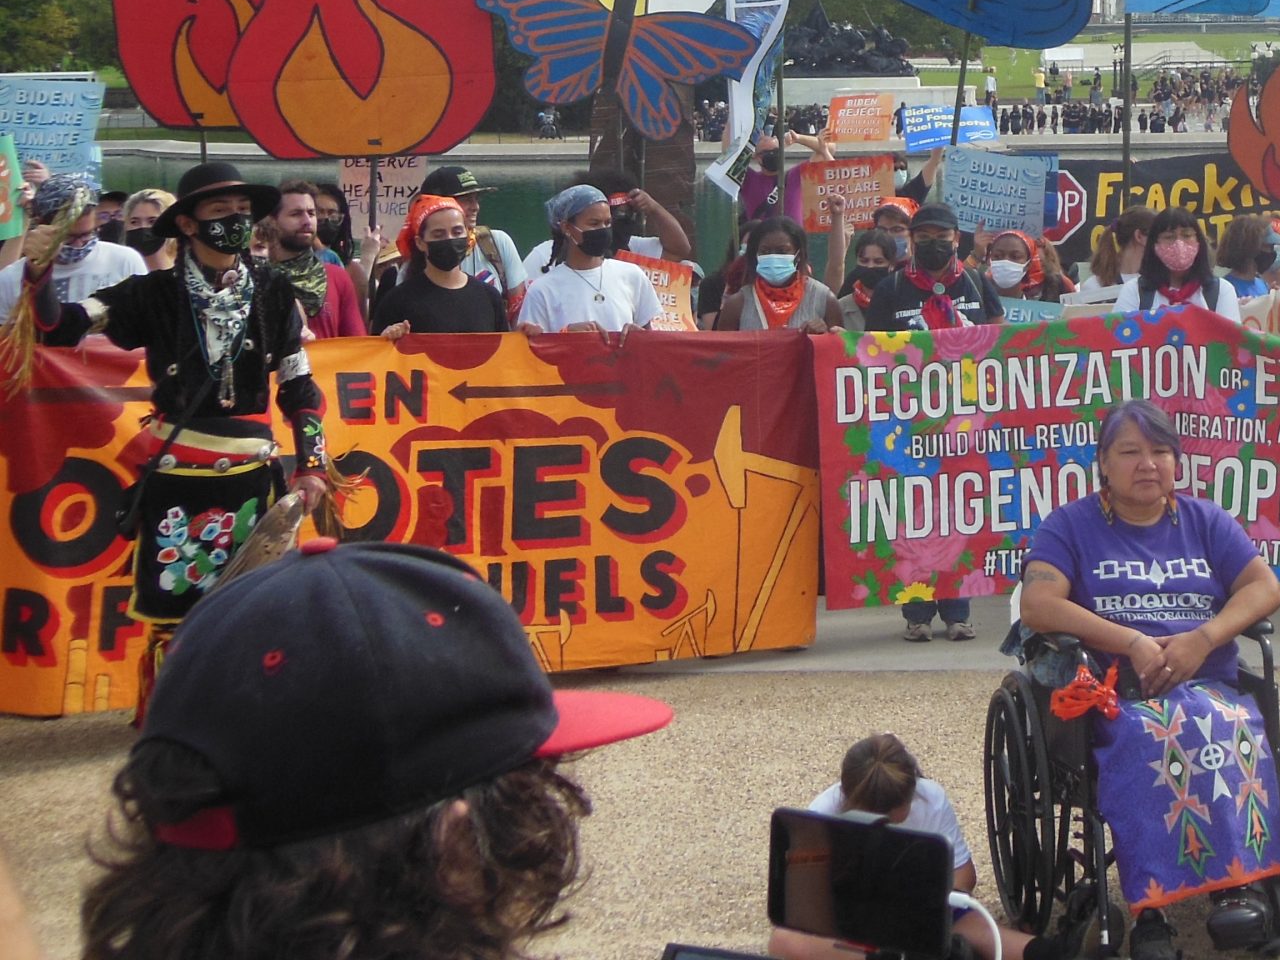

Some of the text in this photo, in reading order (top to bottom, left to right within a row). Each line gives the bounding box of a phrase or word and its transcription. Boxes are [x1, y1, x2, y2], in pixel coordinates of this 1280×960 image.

[16, 89, 75, 106] BIDEN
[847, 98, 878, 107] BIDEN
[0, 109, 84, 126] DECLARE
[838, 107, 882, 117] REJECT
[905, 107, 943, 116] Biden:
[906, 117, 923, 125] No
[907, 123, 931, 133] Fuel
[825, 166, 870, 180] BIDEN
[970, 161, 1019, 182] BIDEN
[818, 181, 881, 196] DECLARE
[959, 176, 1027, 200] DECLARE
[819, 196, 881, 211] CMATE
[958, 194, 1026, 217] CLIMATE
[836, 344, 1207, 424] DECOLONIZATION
[1220, 368, 1242, 390] OR
[1171, 413, 1272, 446] IBERATION,
[912, 421, 1103, 459] BUILD UNTIL REVOL
[849, 462, 1101, 544] INDIGENO
